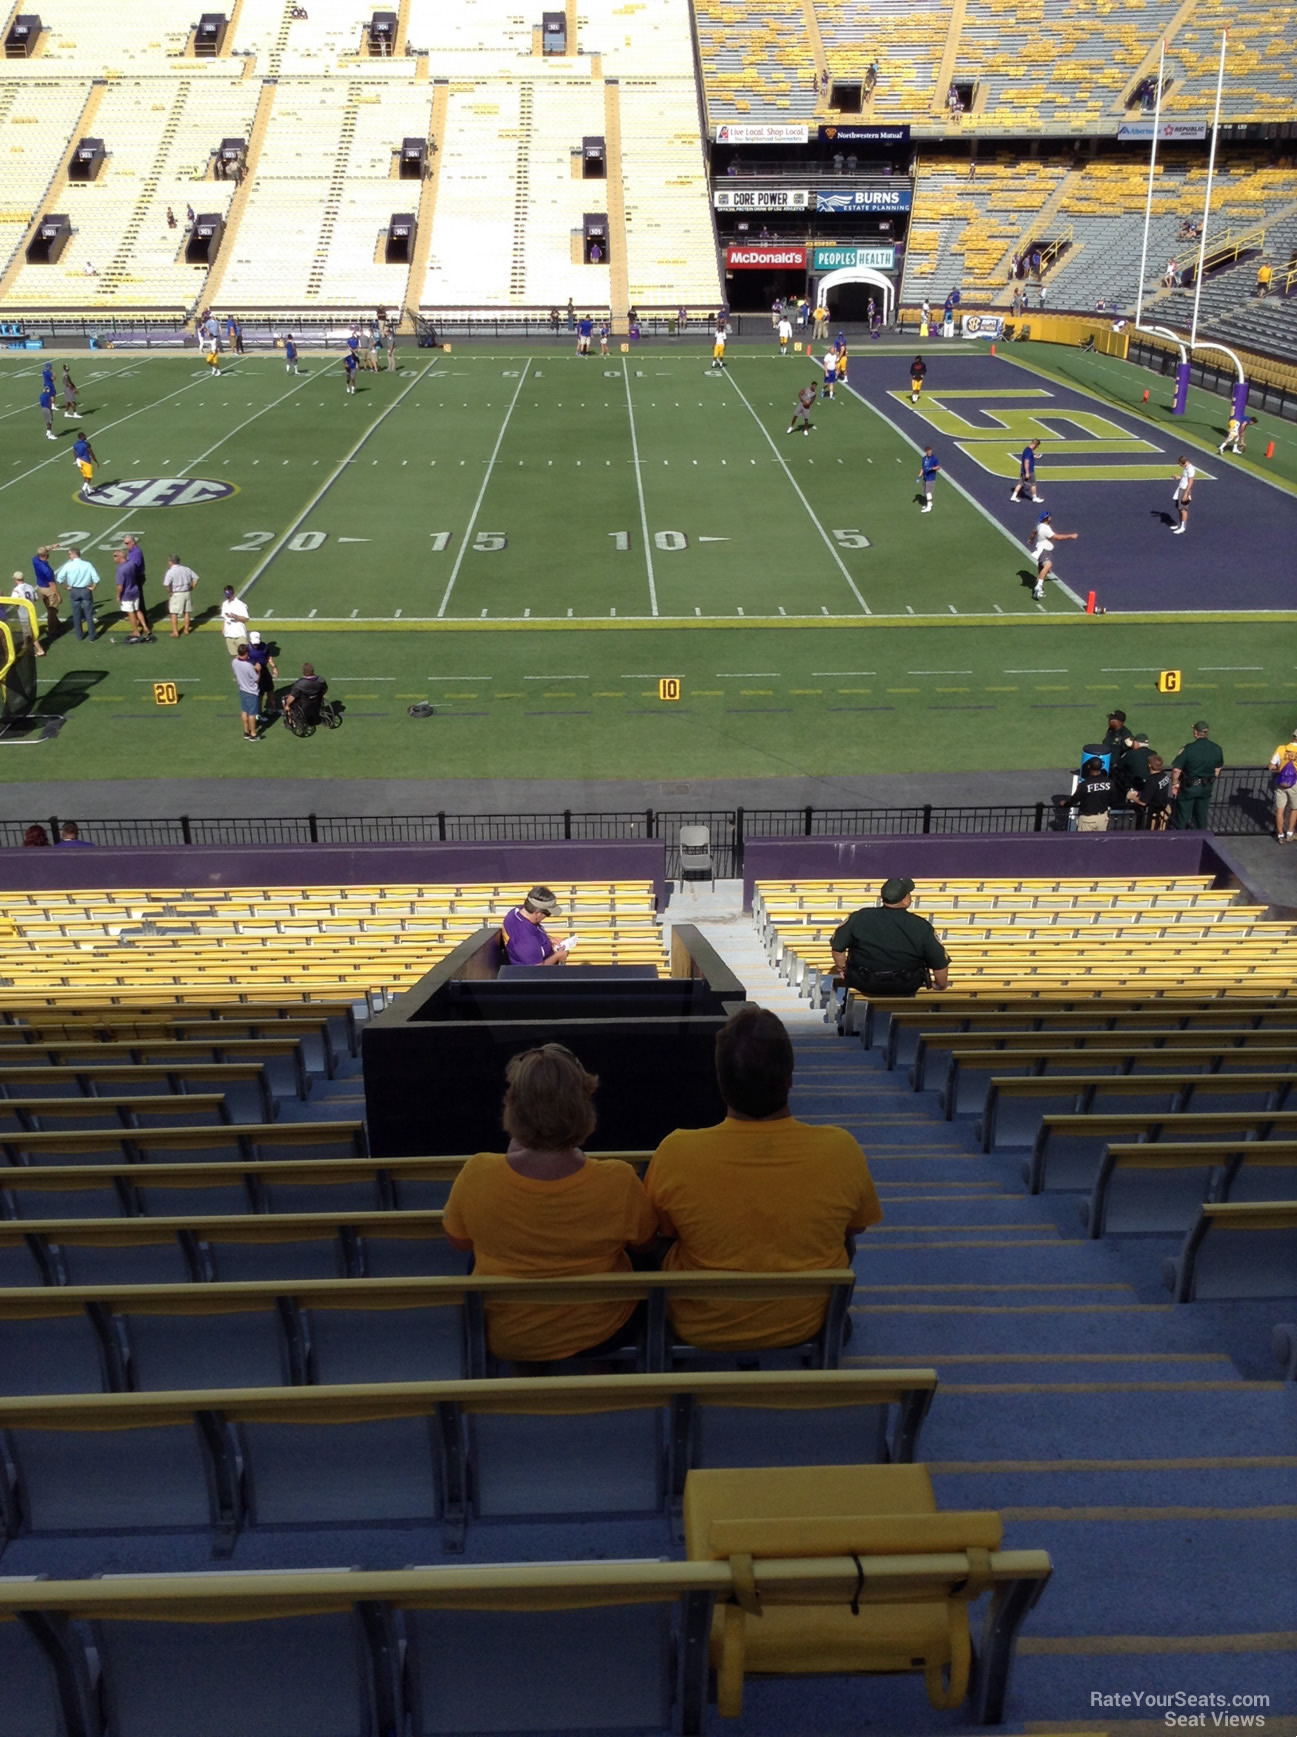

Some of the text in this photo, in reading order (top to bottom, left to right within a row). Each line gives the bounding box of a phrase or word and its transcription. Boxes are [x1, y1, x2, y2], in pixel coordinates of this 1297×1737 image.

[730, 128, 744, 136] Live
[766, 128, 784, 137] Shop
[837, 131, 903, 139] Northwestern Mutual
[734, 193, 755, 205] CORE
[758, 193, 788, 205] POWER
[855, 192, 900, 204] BURNS
[730, 252, 803, 264] McDonald's
[818, 252, 891, 265] PEOPLES HEALTH
[87, 479, 227, 507] SEC
[230, 531, 328, 551] 20
[429, 532, 507, 551] 15
[608, 530, 689, 551] 10
[832, 529, 873, 548] 5
[662, 679, 677, 699] 10
[1165, 671, 1176, 690] G
[156, 684, 176, 703] 20
[1086, 782, 1111, 793] FESS
